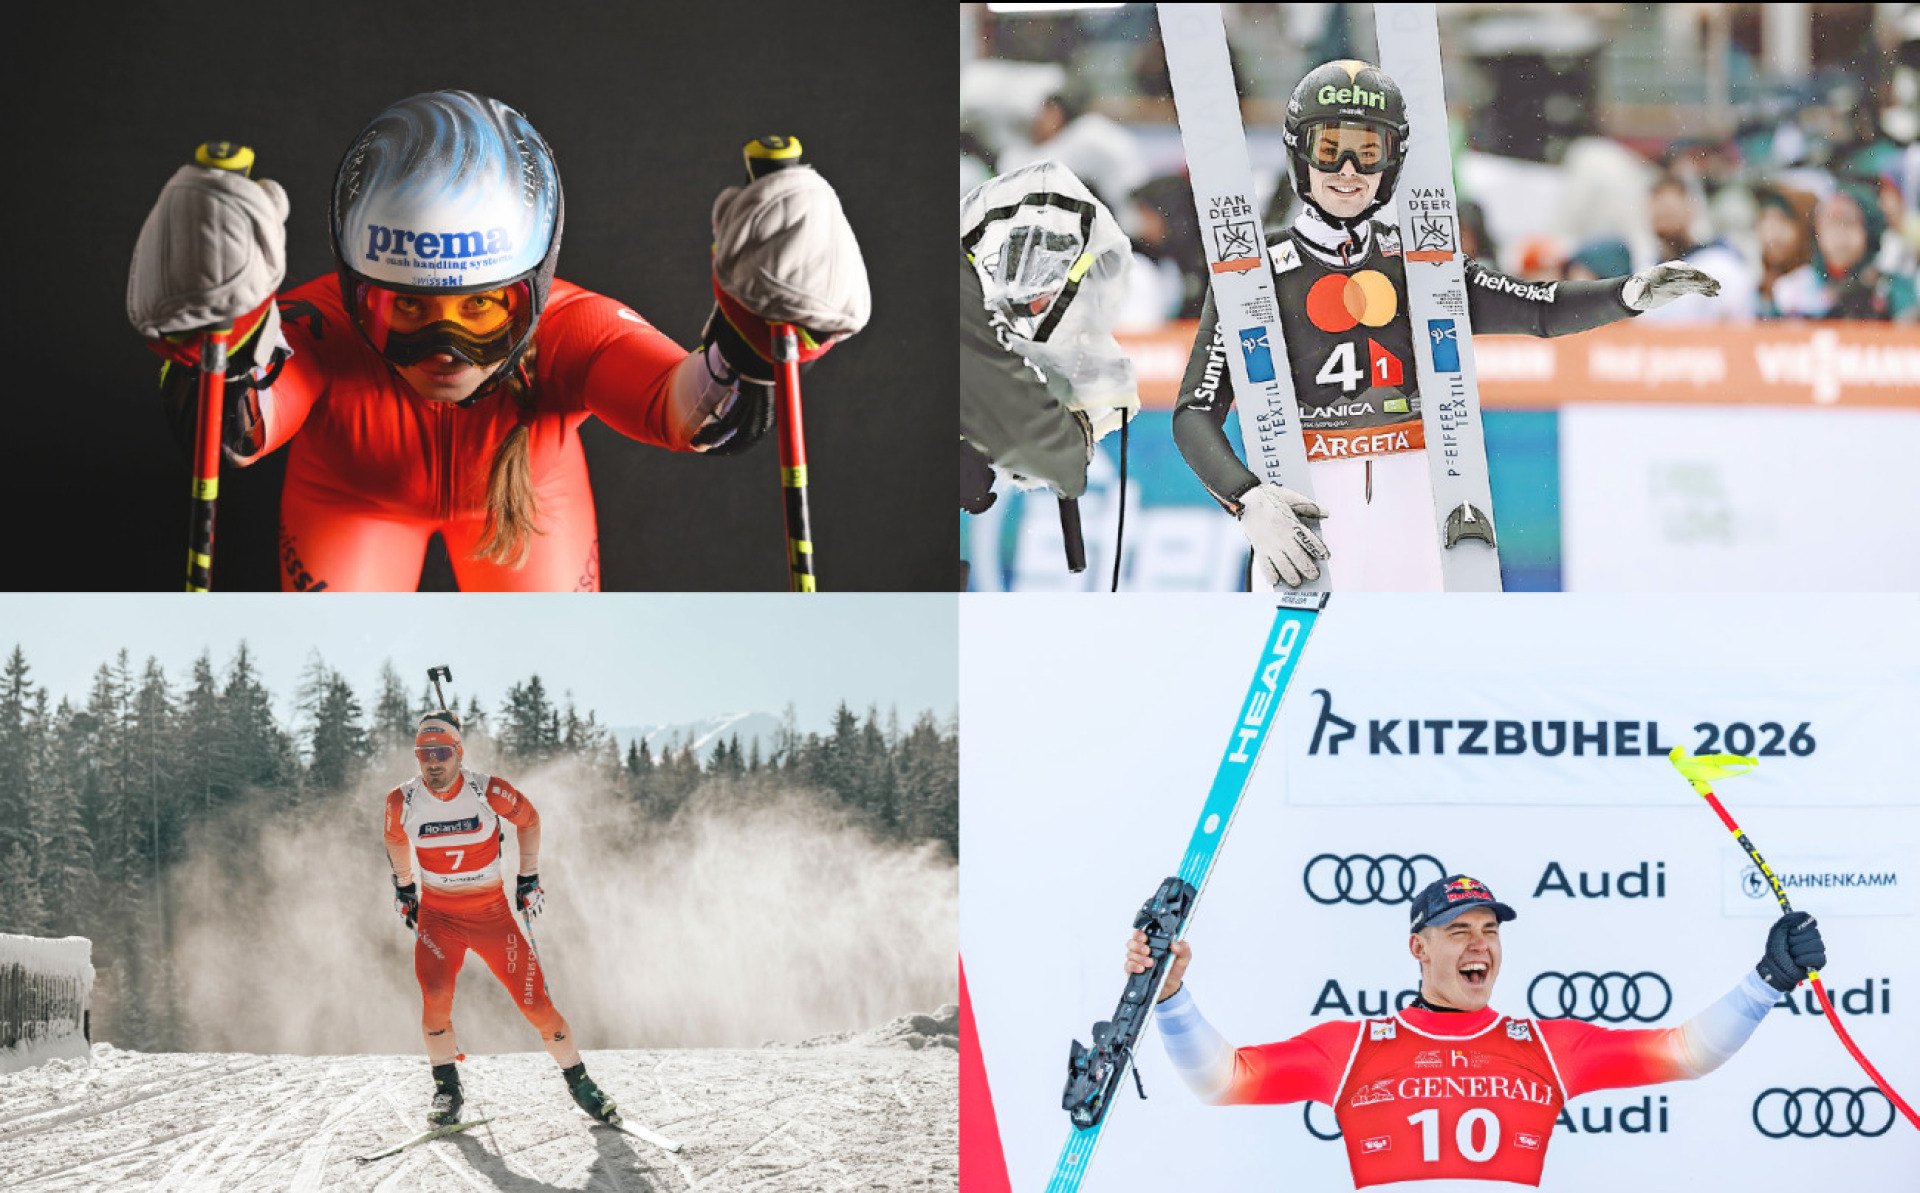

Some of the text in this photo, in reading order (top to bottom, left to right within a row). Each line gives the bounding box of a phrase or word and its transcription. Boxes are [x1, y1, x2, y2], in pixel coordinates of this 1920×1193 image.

[1318, 84, 1385, 111] Gehri
[1211, 195, 1246, 207] VAN
[1409, 200, 1450, 210] DEER
[1411, 188, 1445, 198] VAN
[1210, 205, 1252, 219] DEER
[366, 224, 513, 261] prema
[413, 258, 467, 270] handling
[1316, 342, 1364, 392] 4
[1375, 357, 1389, 380] 1
[1265, 382, 1287, 437] TEXTIL
[1300, 402, 1375, 419] LANICA
[1449, 375, 1468, 428] TEXTIL
[1256, 413, 1284, 488] PFEIFFER
[1228, 619, 1301, 763] HEAD
[1693, 721, 1816, 757] 2026
[425, 821, 462, 834] Roland
[445, 850, 465, 871] 7
[1532, 861, 1666, 899] Audi
[1777, 872, 1898, 888] HAHNENKAMM
[1447, 890, 1492, 902] Red Bull
[1398, 1076, 1552, 1105] GENERALI
[1407, 1108, 1500, 1163] 10
